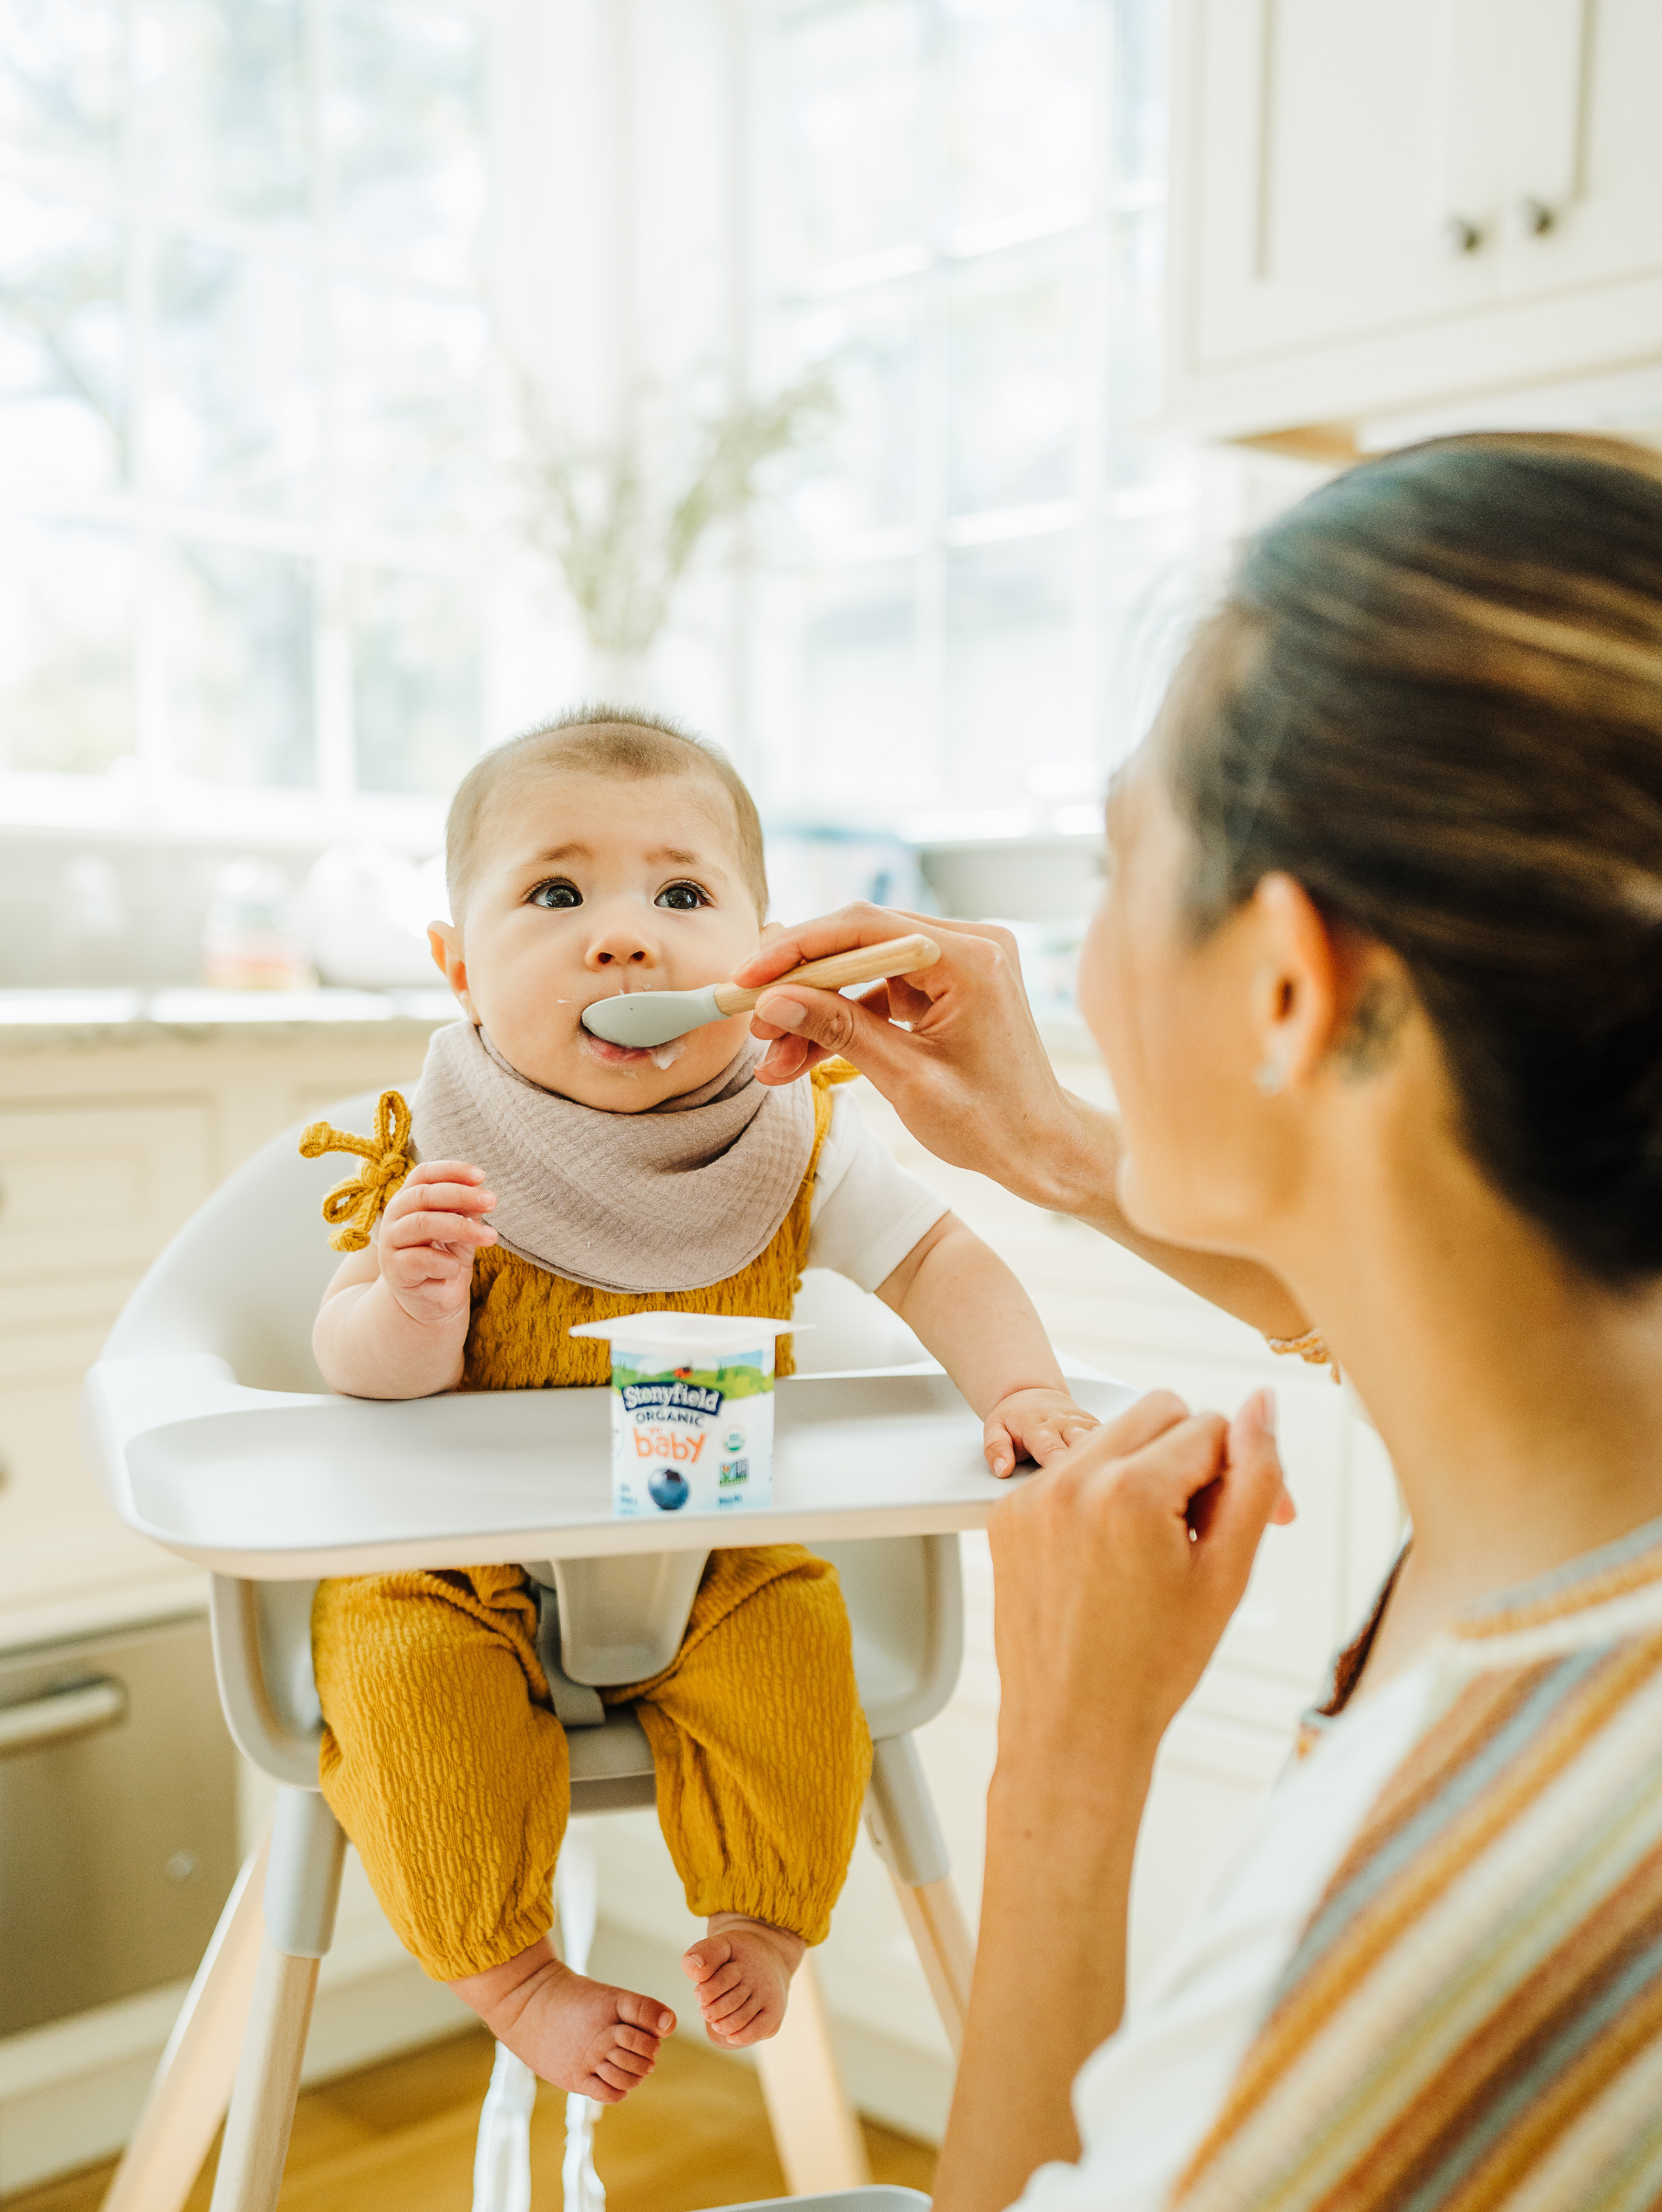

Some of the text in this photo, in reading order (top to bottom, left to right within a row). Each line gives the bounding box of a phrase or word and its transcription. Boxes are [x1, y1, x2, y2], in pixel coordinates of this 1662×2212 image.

[624, 1382, 720, 1412] Stonyfield
[635, 1411, 704, 1427] ORGANIC
[633, 1427, 707, 1464] baby
